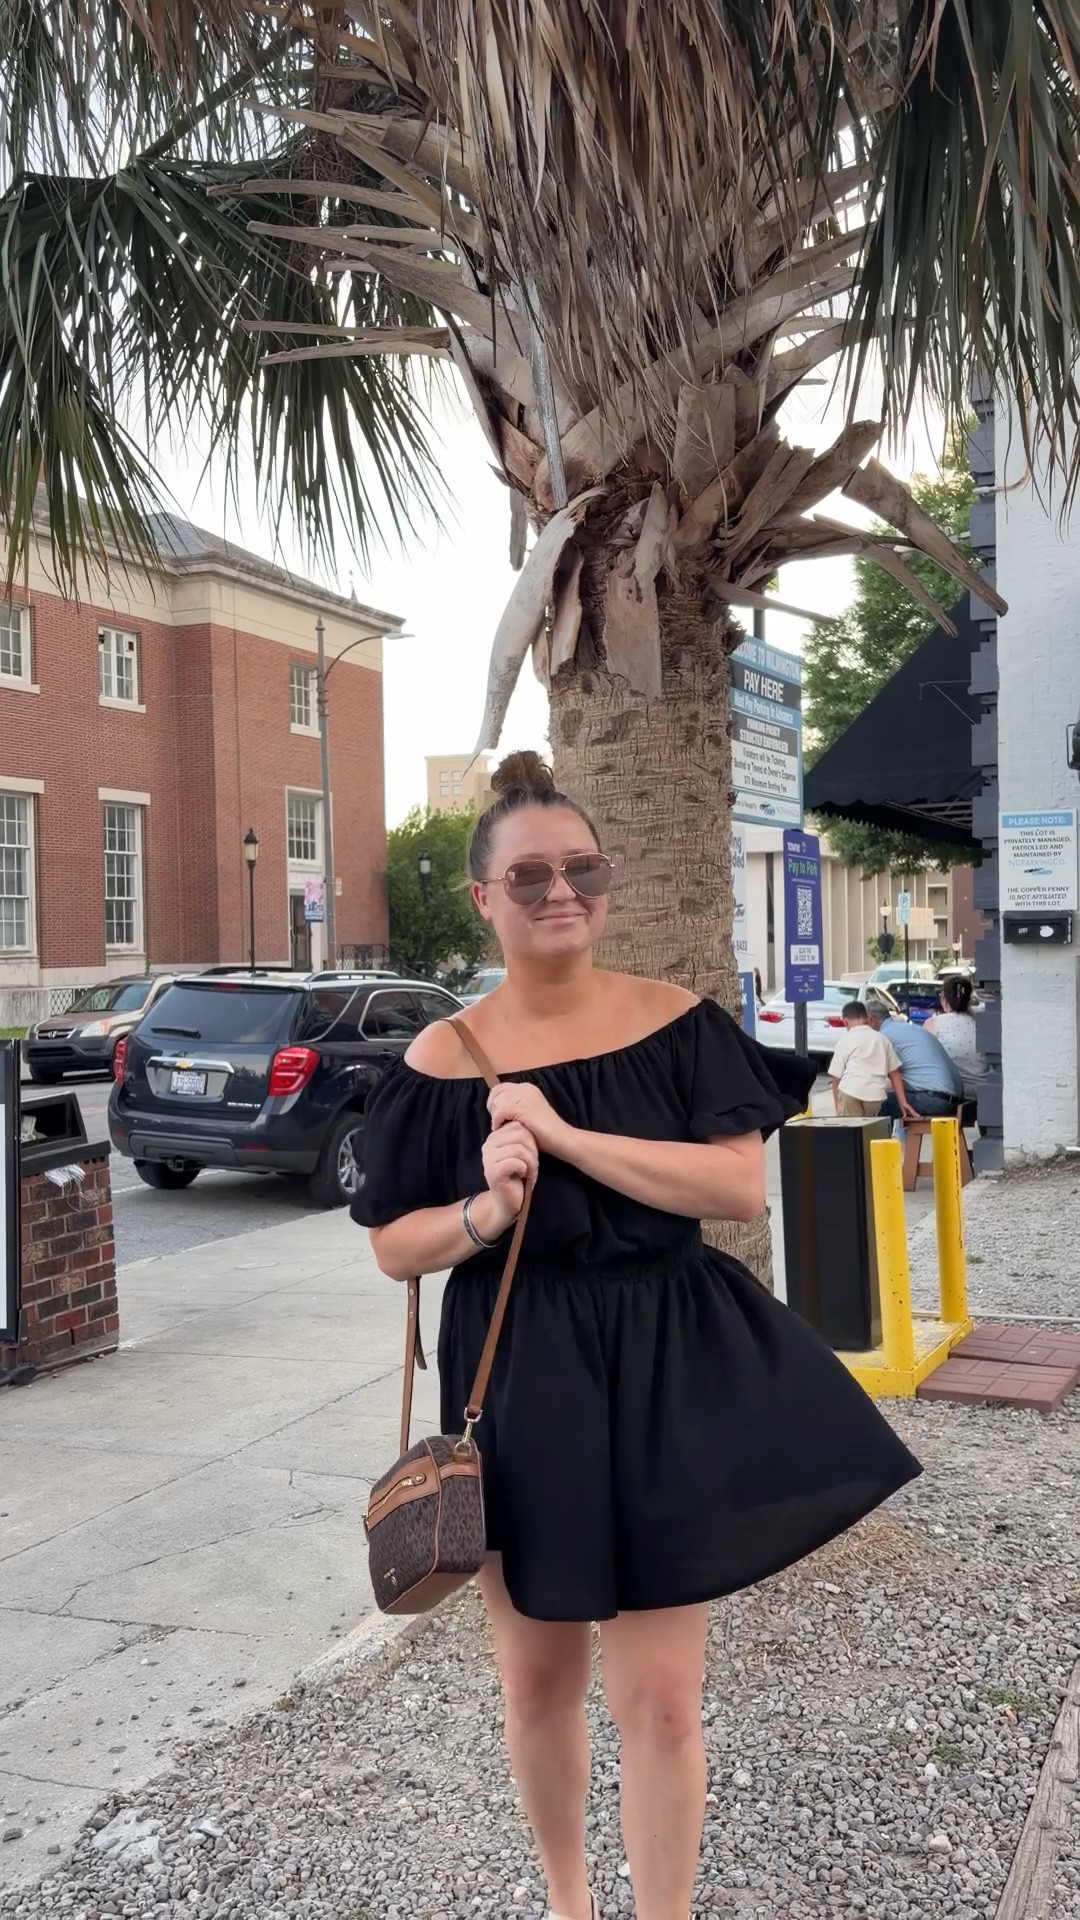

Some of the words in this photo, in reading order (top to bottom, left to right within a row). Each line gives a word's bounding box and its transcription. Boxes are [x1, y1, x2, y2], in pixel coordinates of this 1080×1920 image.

[744, 669, 760, 694] PAY
[761, 676, 784, 703] HERE
[745, 695, 753, 714] Pay
[753, 698, 770, 720] Parking
[775, 706, 794, 724] Advance
[740, 728, 762, 747] STRICTLY
[763, 735, 788, 753] ENFORCED
[1008, 816, 1040, 826] PLEASE
[1041, 815, 1067, 825] NOTE:
[788, 858, 799, 877] Pay
[800, 861, 805, 874] to
[806, 861, 818, 876] Park
